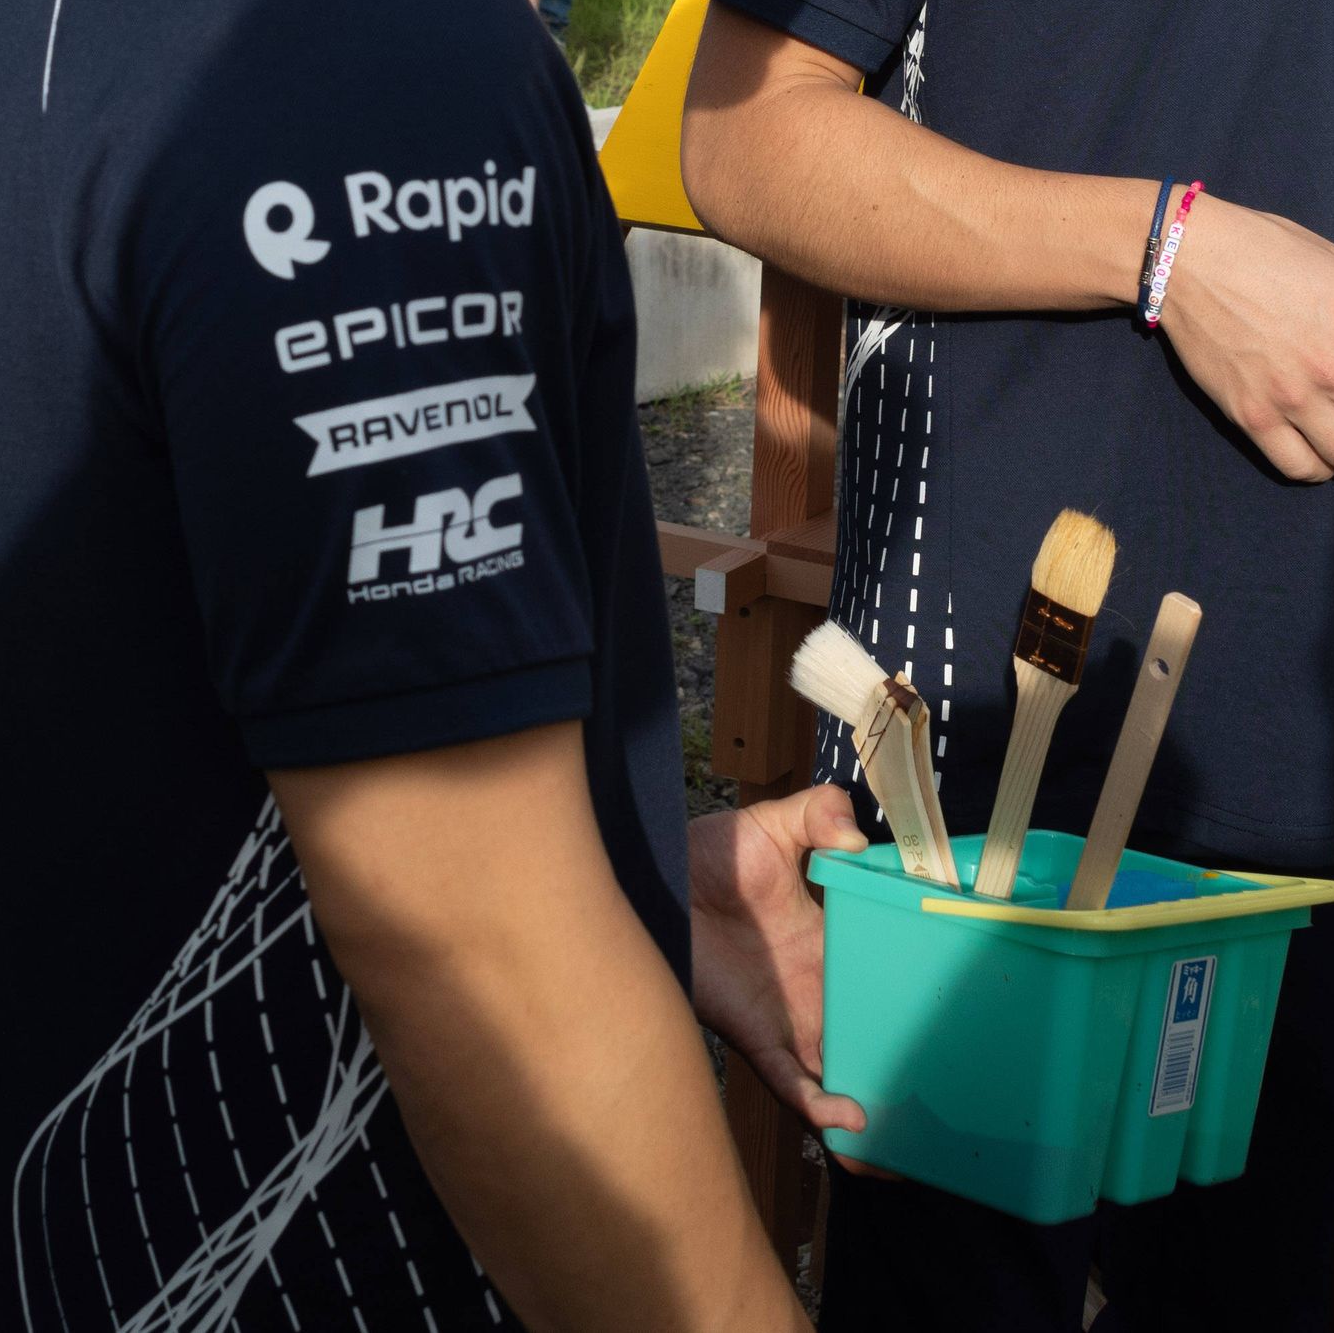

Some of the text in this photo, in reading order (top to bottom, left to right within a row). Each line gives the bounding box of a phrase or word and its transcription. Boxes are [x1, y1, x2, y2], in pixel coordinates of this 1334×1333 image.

[344, 160, 536, 242] Rapid
[347, 472, 524, 585] HRC
[347, 551, 525, 604] Honda RACING
